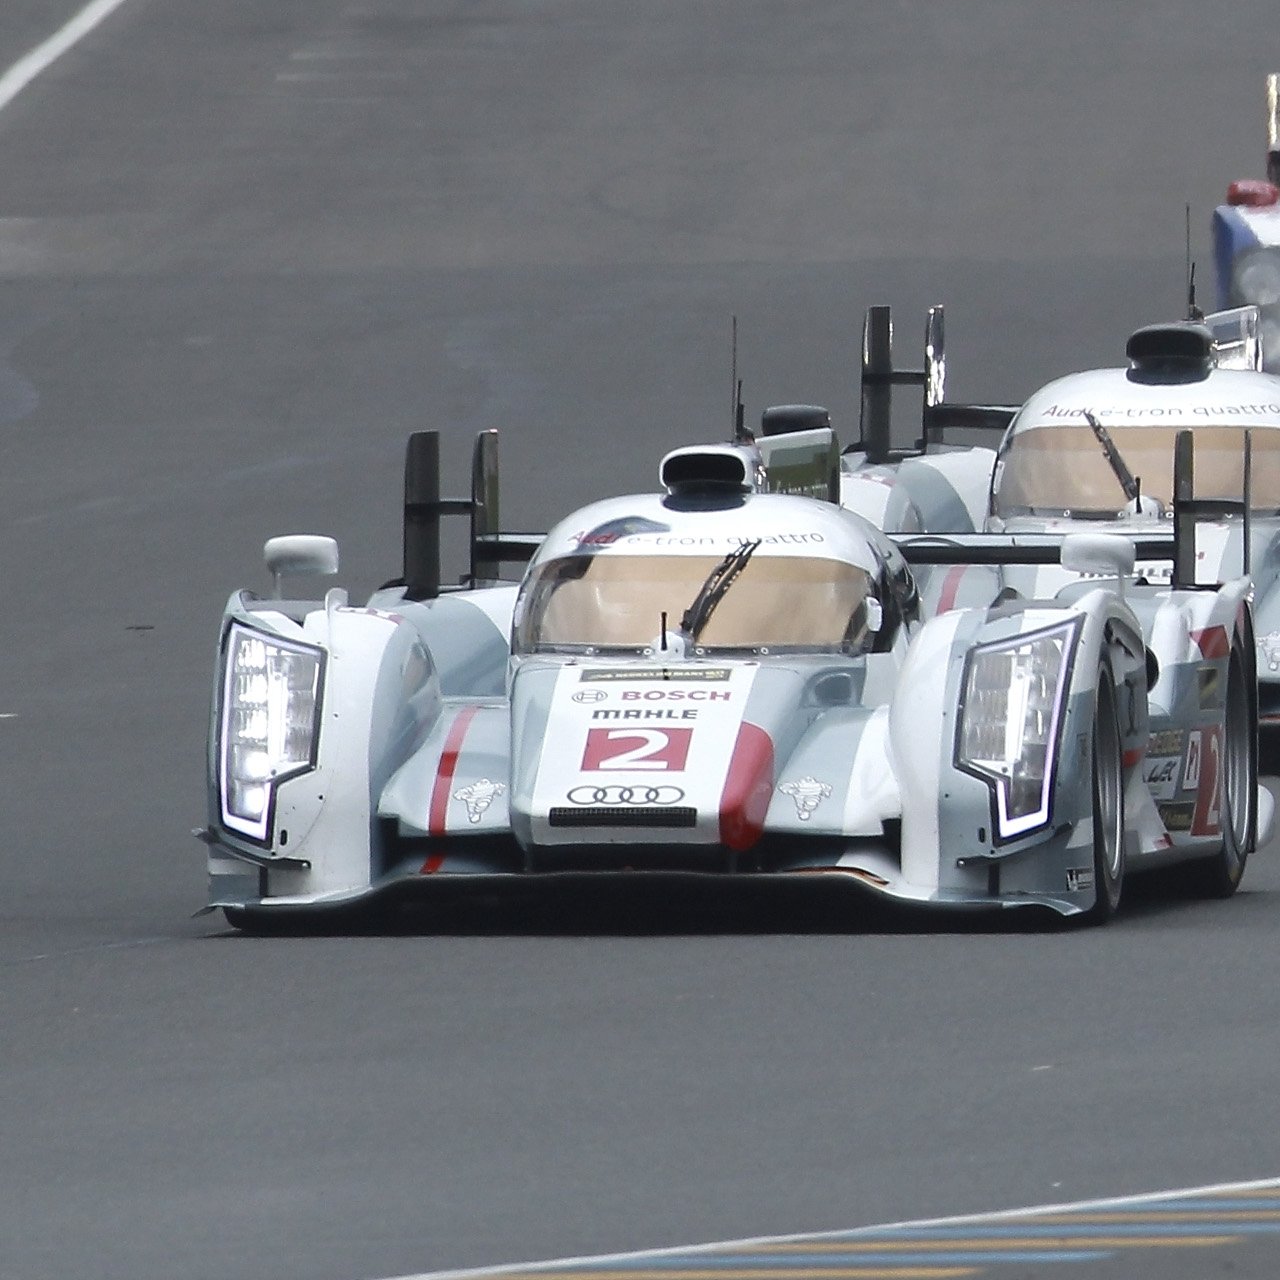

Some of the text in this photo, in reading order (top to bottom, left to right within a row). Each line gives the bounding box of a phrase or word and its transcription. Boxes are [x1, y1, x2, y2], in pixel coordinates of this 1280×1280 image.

[1099, 407, 1183, 418] e-tron
[627, 534, 715, 546] e-tron
[621, 690, 732, 701] BOSCH
[591, 708, 699, 720] MAHLE
[597, 728, 670, 770] 2
